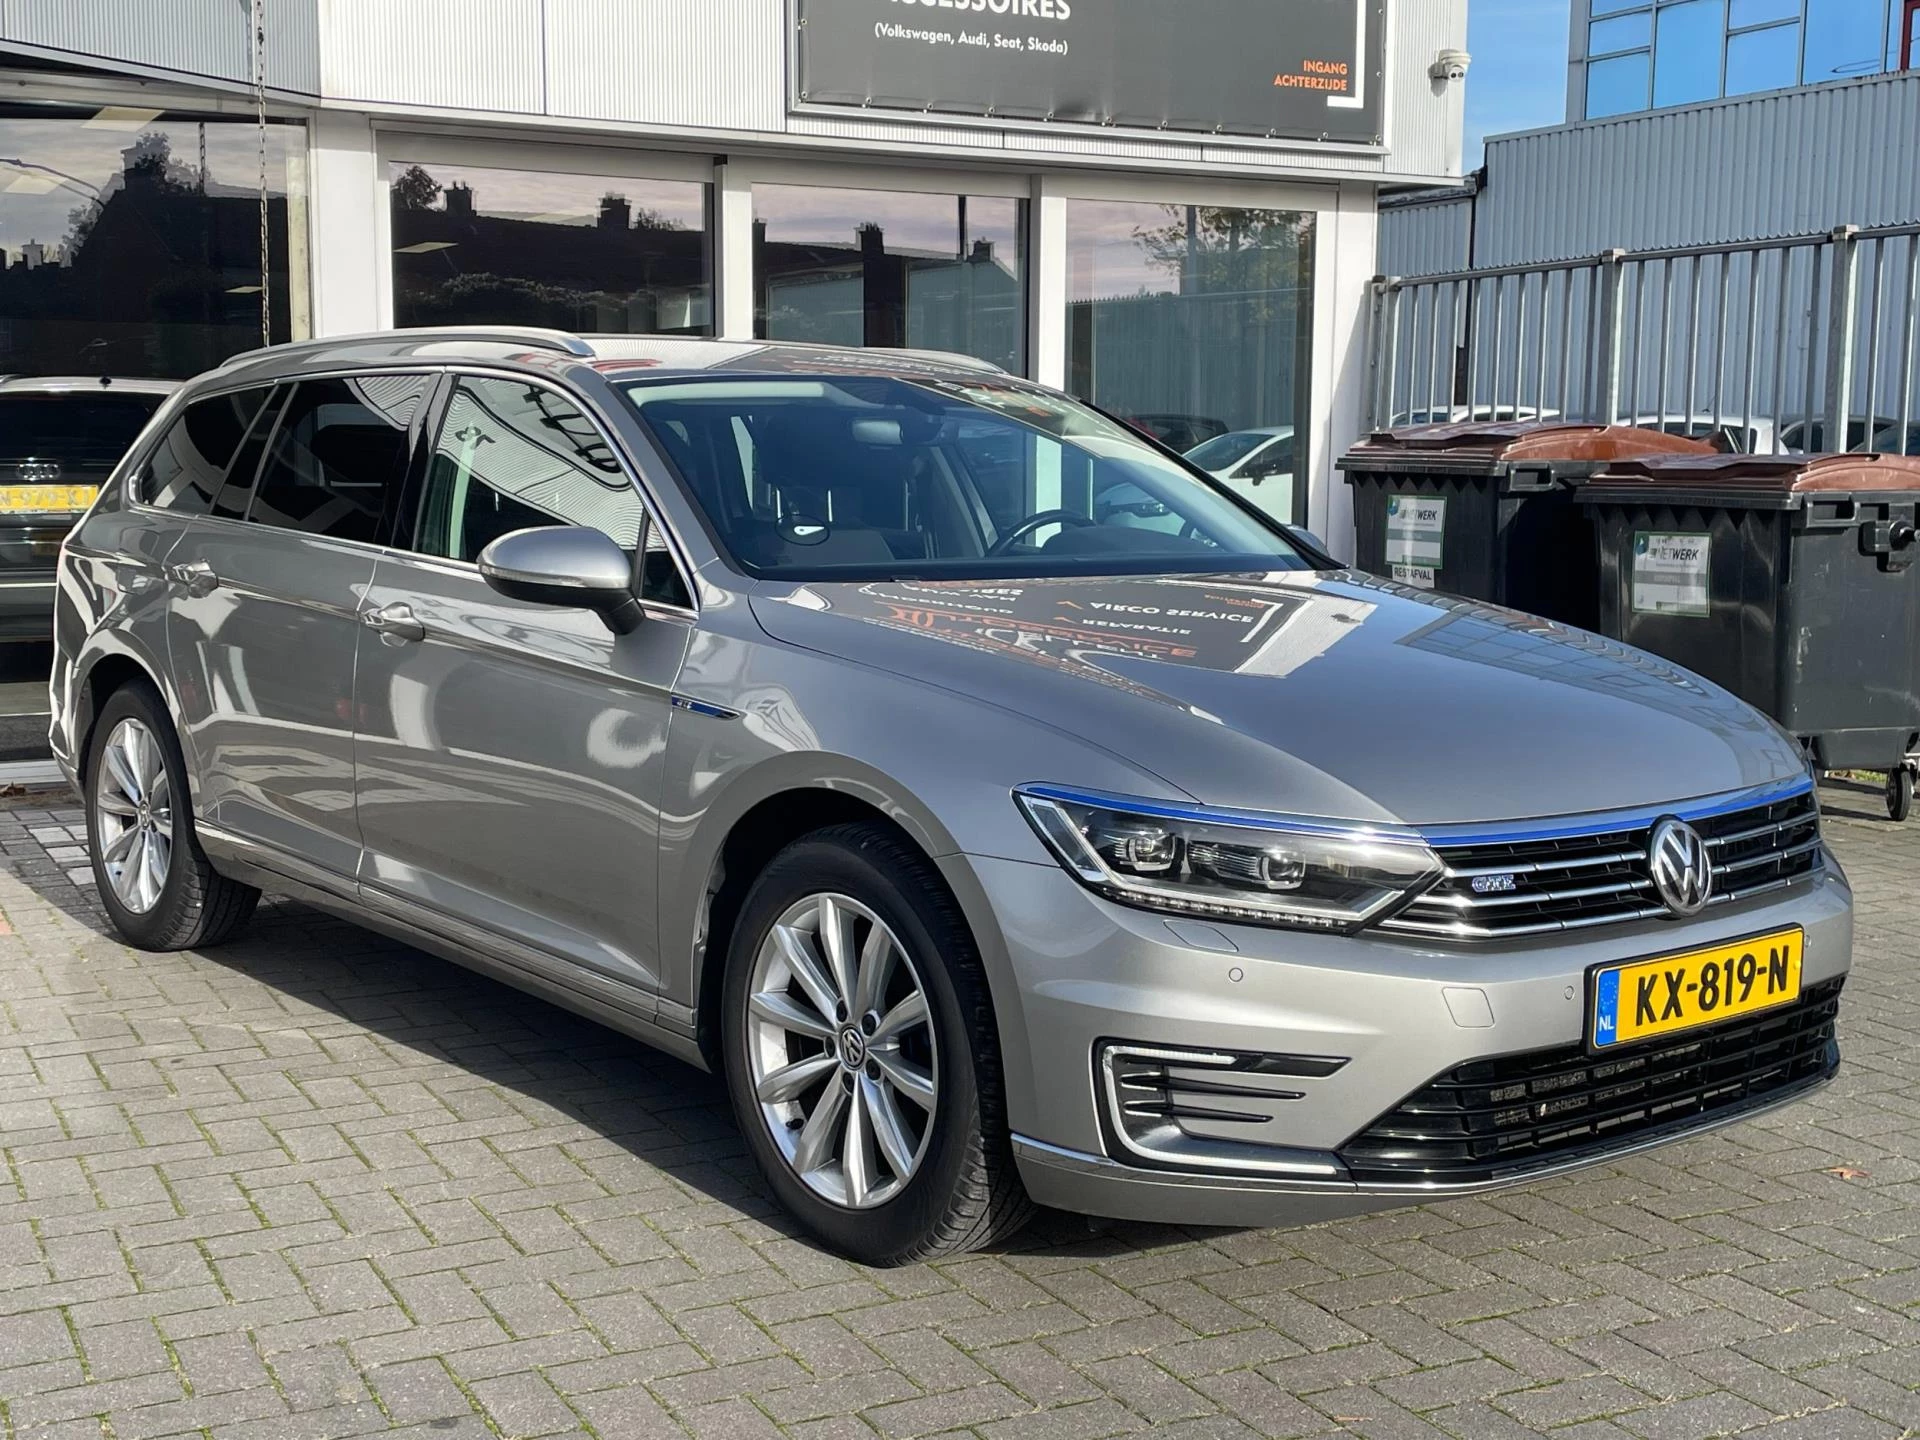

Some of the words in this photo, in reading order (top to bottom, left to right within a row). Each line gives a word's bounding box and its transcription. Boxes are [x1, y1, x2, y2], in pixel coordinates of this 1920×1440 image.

[874, 22, 955, 45] (Volkswagen,
[958, 31, 991, 48] Audi,
[994, 34, 1024, 52] Seat,
[1027, 37, 1069, 56] Skoda)
[1303, 60, 1348, 75] INGANG
[1274, 75, 1348, 91] ACHTERZIJDE
[1471, 874, 1516, 893] GTE
[1635, 945, 1790, 1027] KX-819-N
[1599, 1015, 1615, 1032] NL
